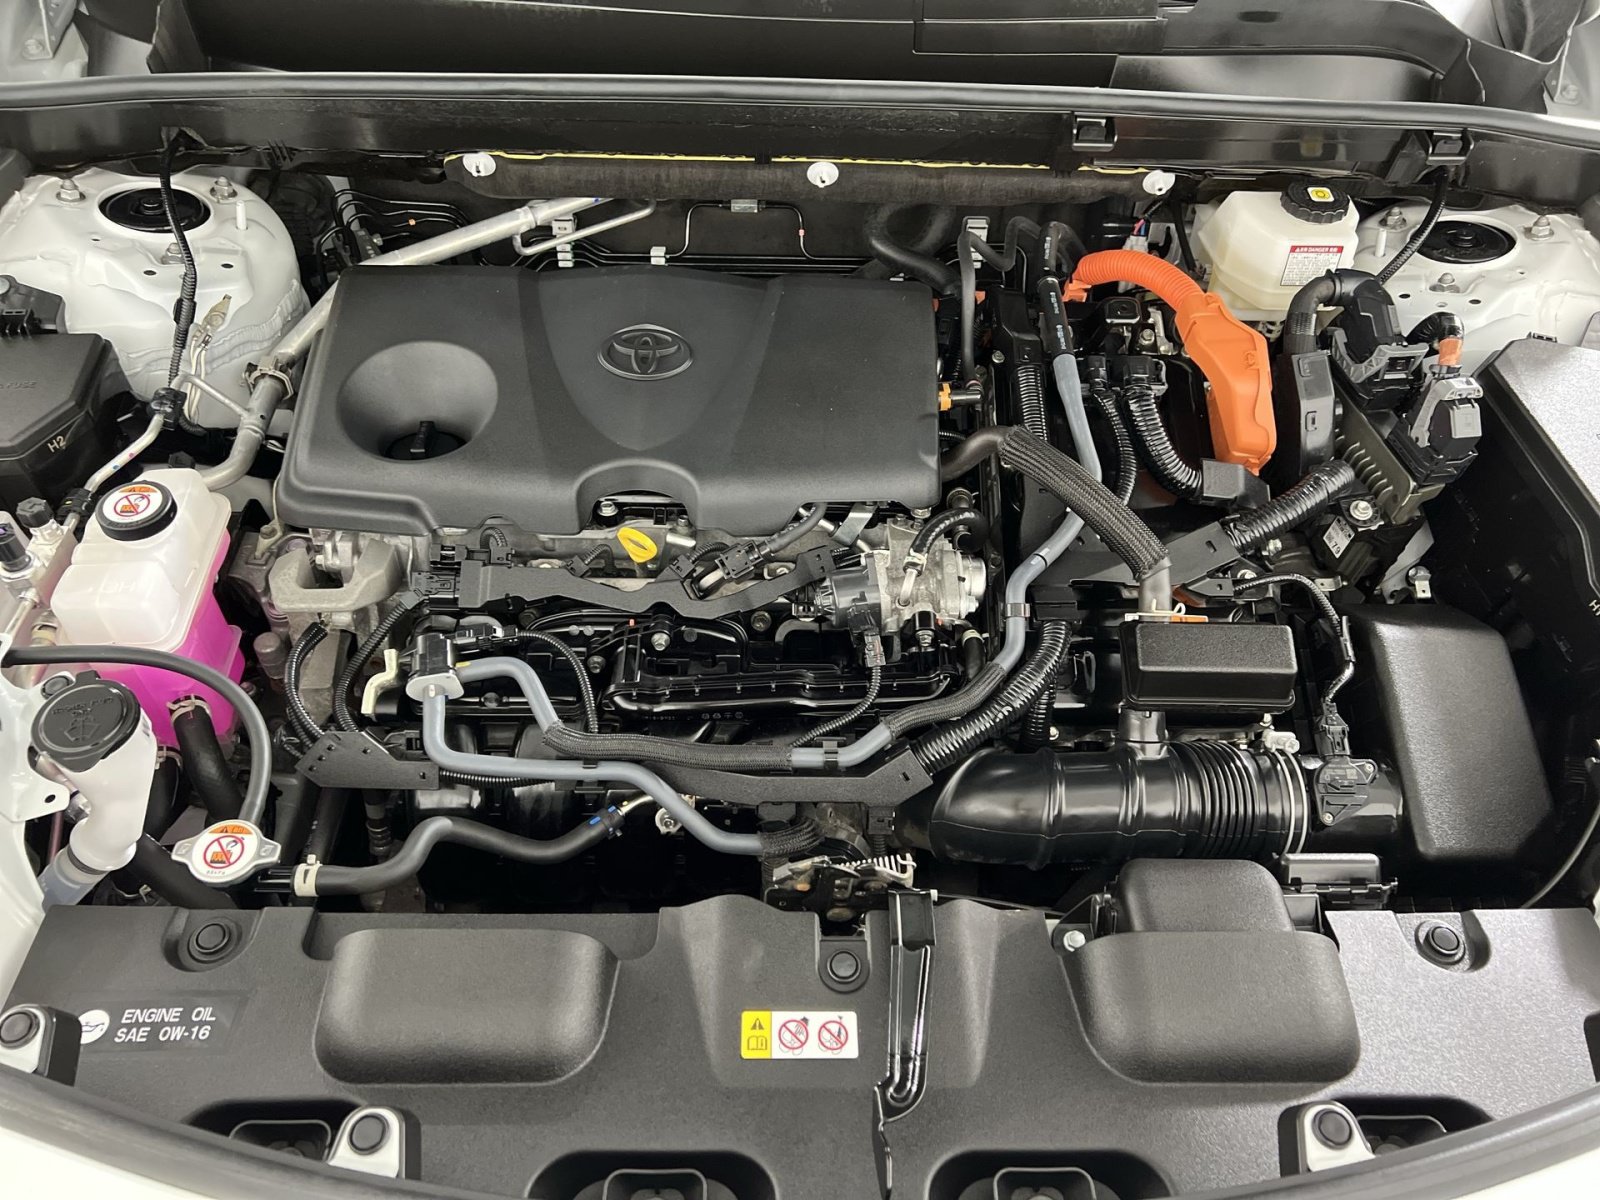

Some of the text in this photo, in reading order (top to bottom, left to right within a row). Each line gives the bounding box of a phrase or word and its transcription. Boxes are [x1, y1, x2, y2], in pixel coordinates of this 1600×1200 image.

[47, 435, 66, 453] H2
[121, 1007, 216, 1024] ENGINE OIL
[114, 1026, 211, 1043] SAE 0W-16
